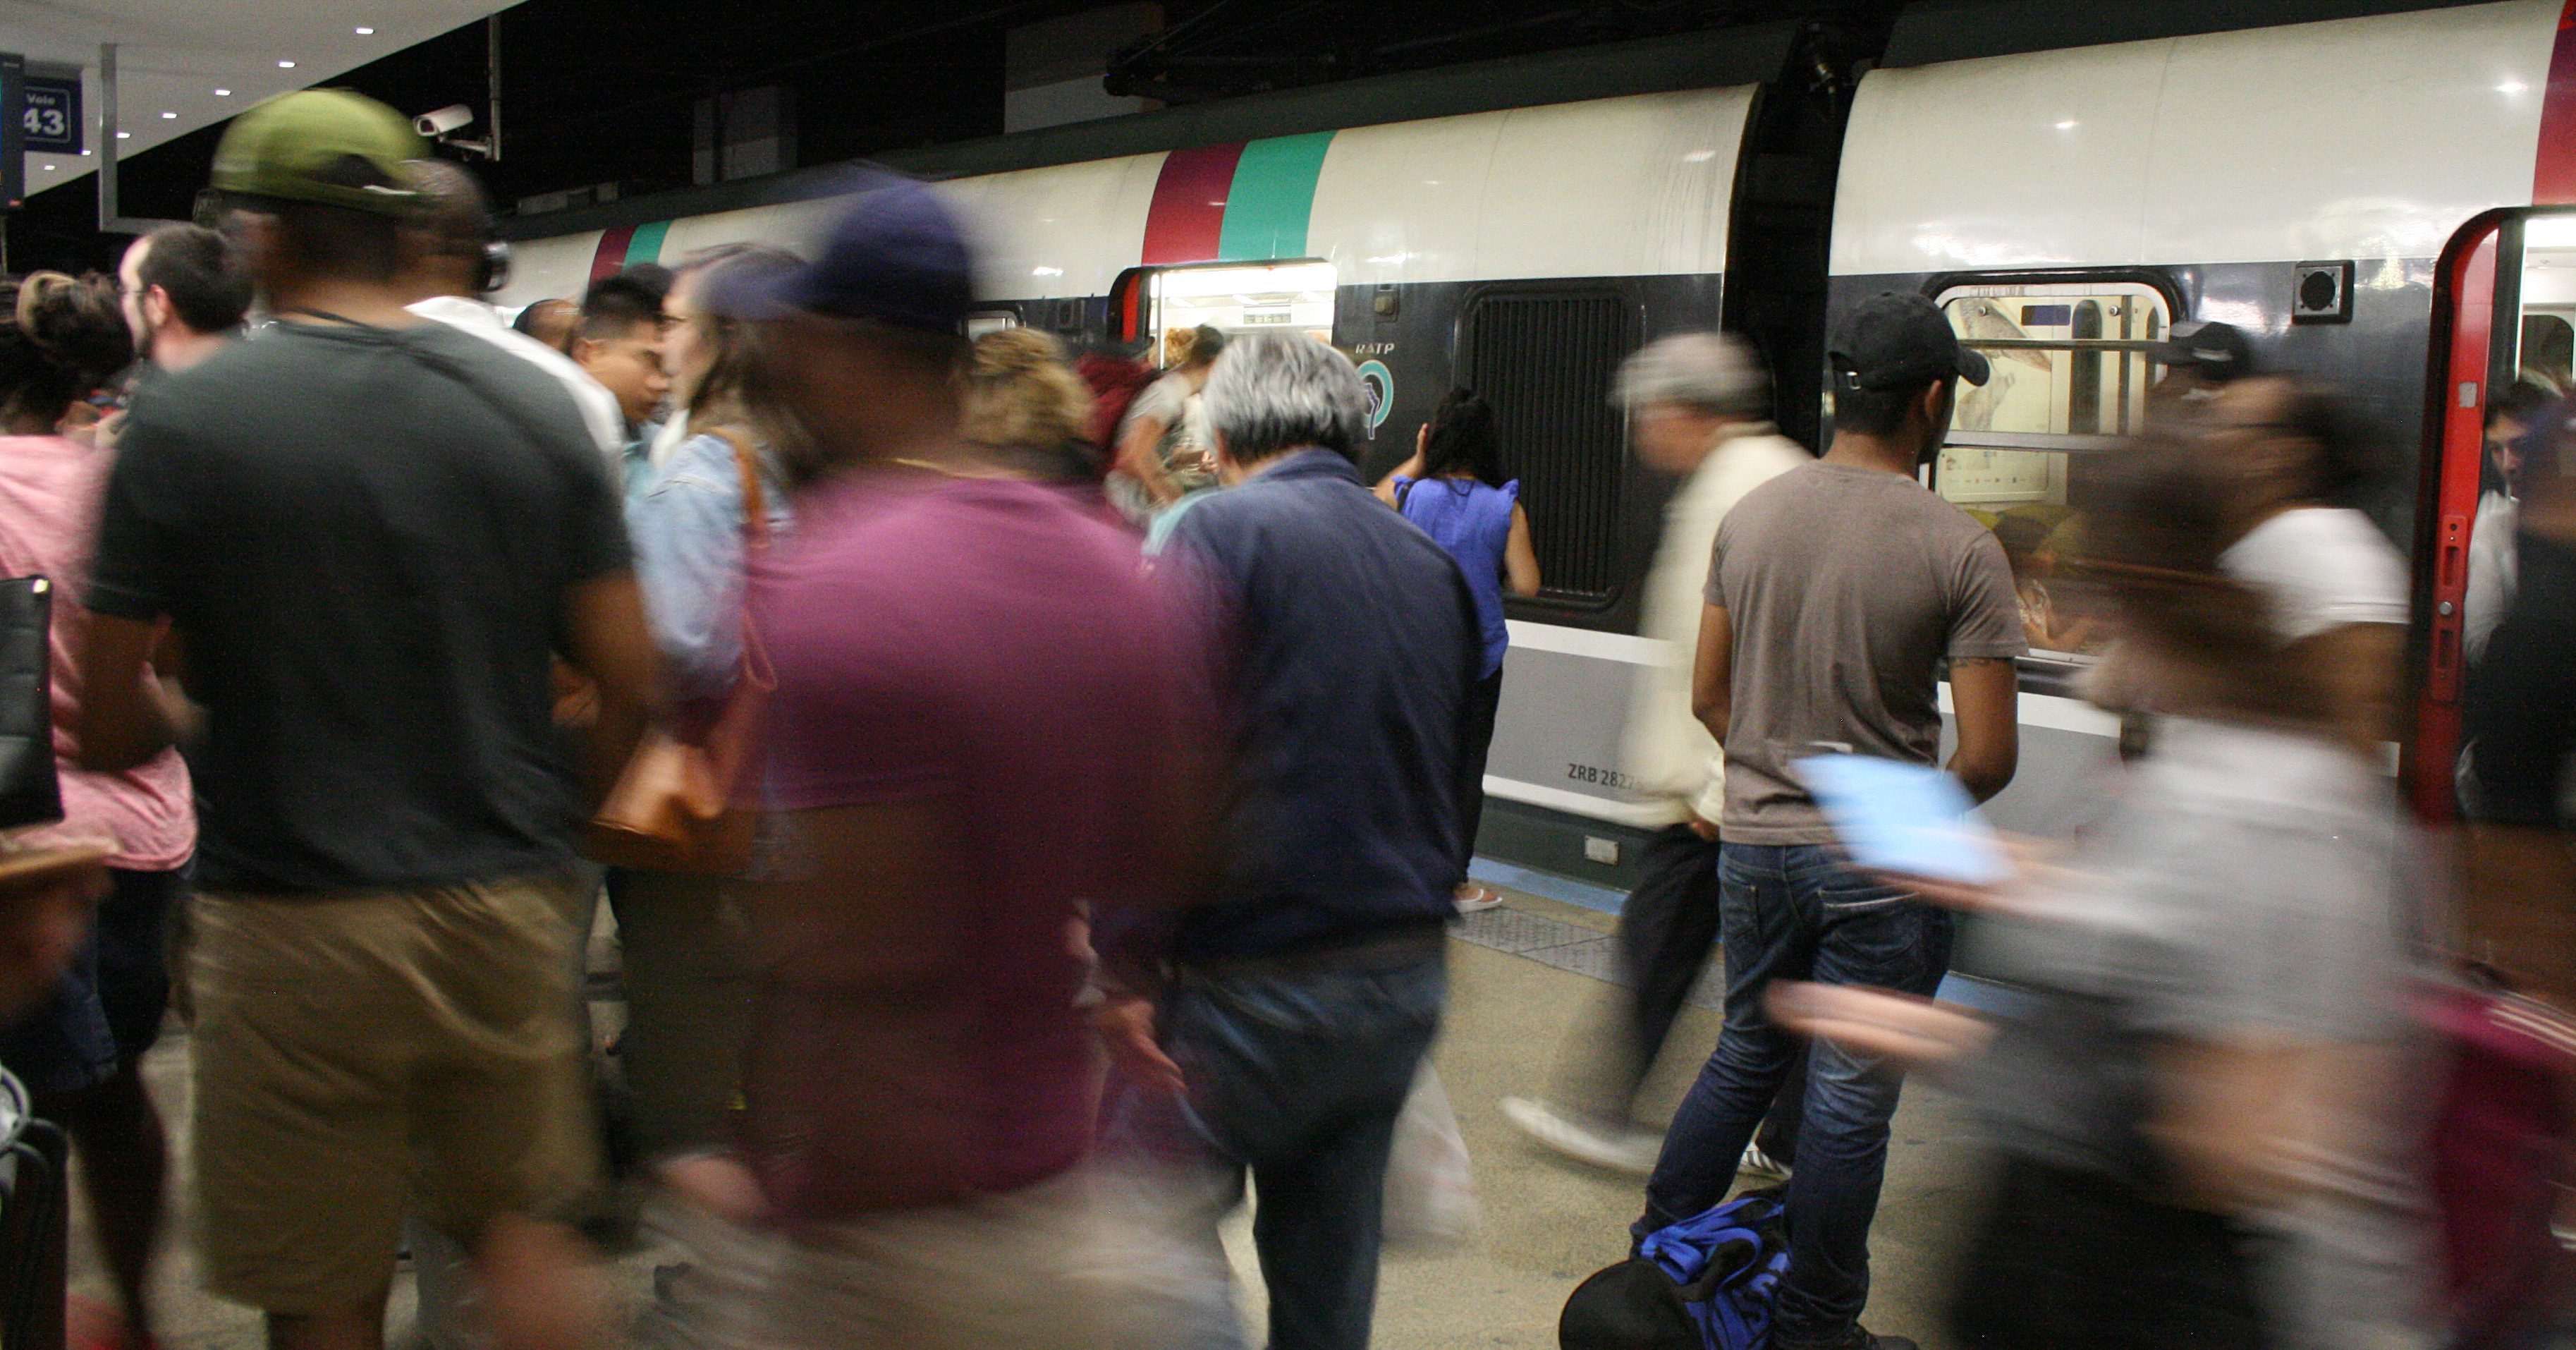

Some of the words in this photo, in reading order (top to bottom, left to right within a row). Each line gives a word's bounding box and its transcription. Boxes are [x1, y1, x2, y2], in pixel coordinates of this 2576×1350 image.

[27, 93, 56, 105] Voie
[23, 107, 65, 135] 43
[1355, 342, 1395, 355] RATP
[1568, 763, 1597, 783] ZRB
[1600, 770, 1642, 791] 2827
